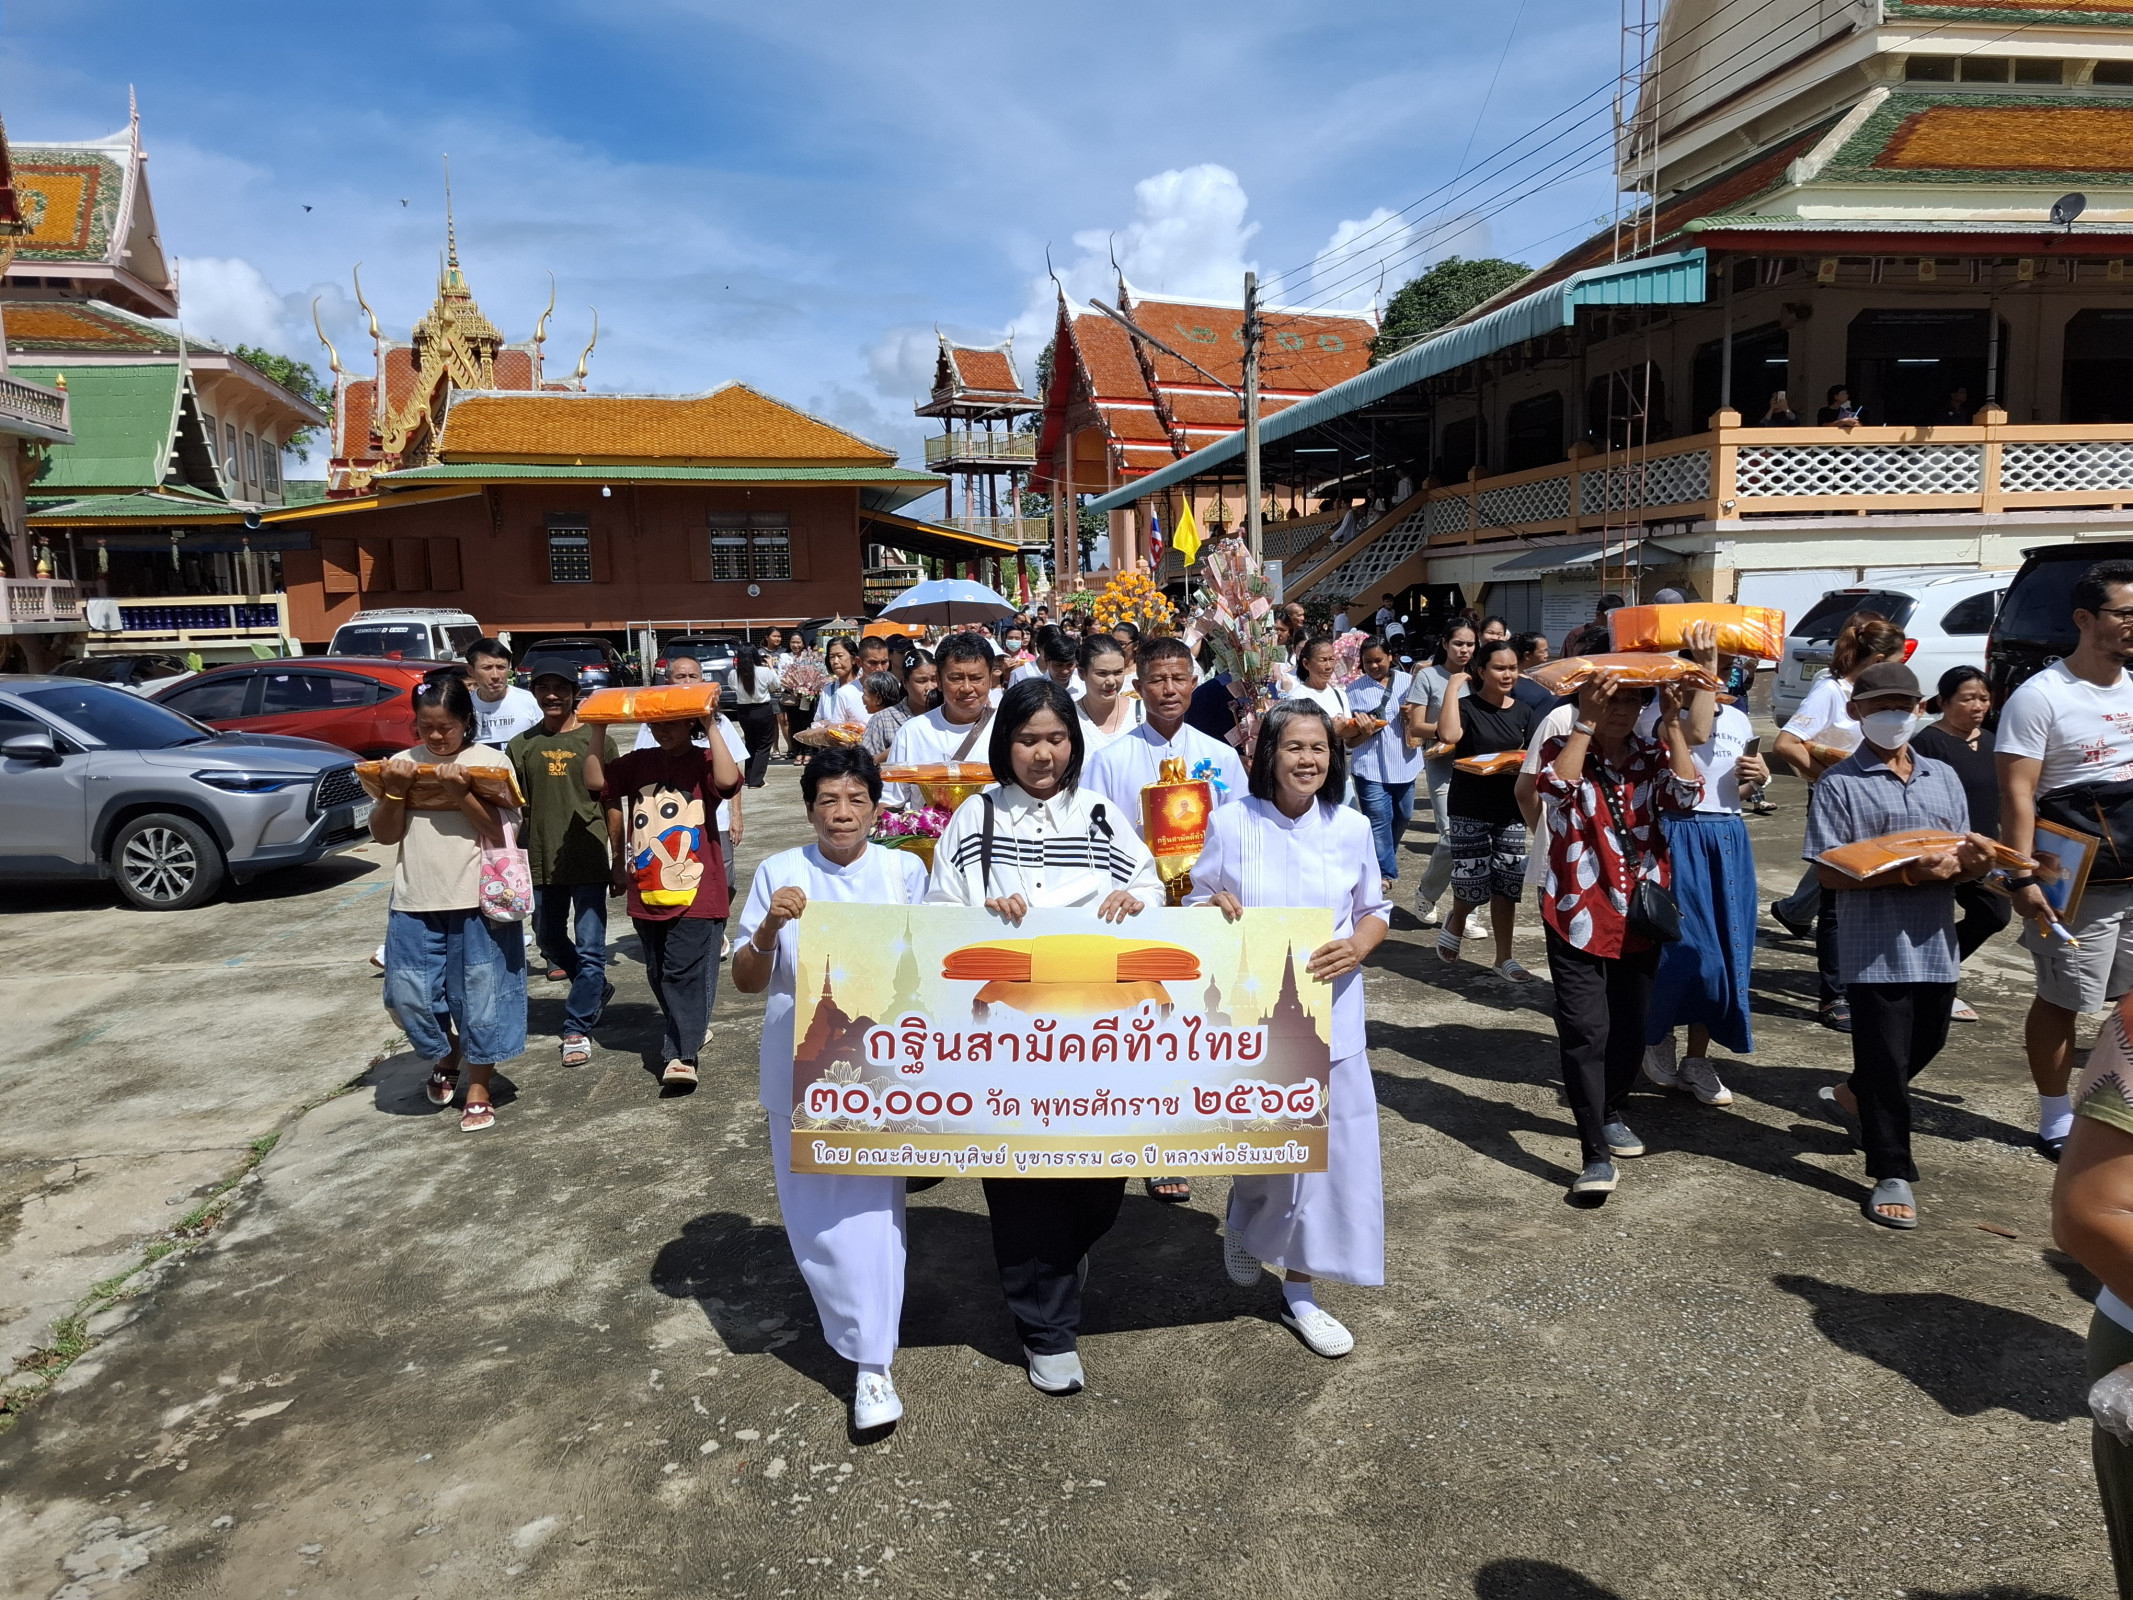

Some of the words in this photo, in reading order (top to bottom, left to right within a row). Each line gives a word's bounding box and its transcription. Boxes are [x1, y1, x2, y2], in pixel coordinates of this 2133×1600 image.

[481, 719, 498, 729] CITY
[499, 717, 515, 726] TRIP
[548, 762, 567, 772] BOY
[869, 1004, 1263, 1075] กฐินสามัคคีทั่วไทย
[810, 1087, 974, 1121] ๓๐,๐๐๐
[986, 1087, 1021, 1117] วัด
[1030, 1088, 1180, 1128] พุทธศักราช
[1193, 1084, 1316, 1115] ๒๕๖๘
[814, 1142, 850, 1162] โดย
[857, 1144, 1007, 1171] คณะศิษยานุศิษย์
[1014, 1151, 1102, 1171] บูชาธรรม
[1110, 1151, 1137, 1166] ๘๑
[1144, 1145, 1157, 1165] ปี
[1164, 1143, 1308, 1165] หลวงพ่อธัมมชโย
